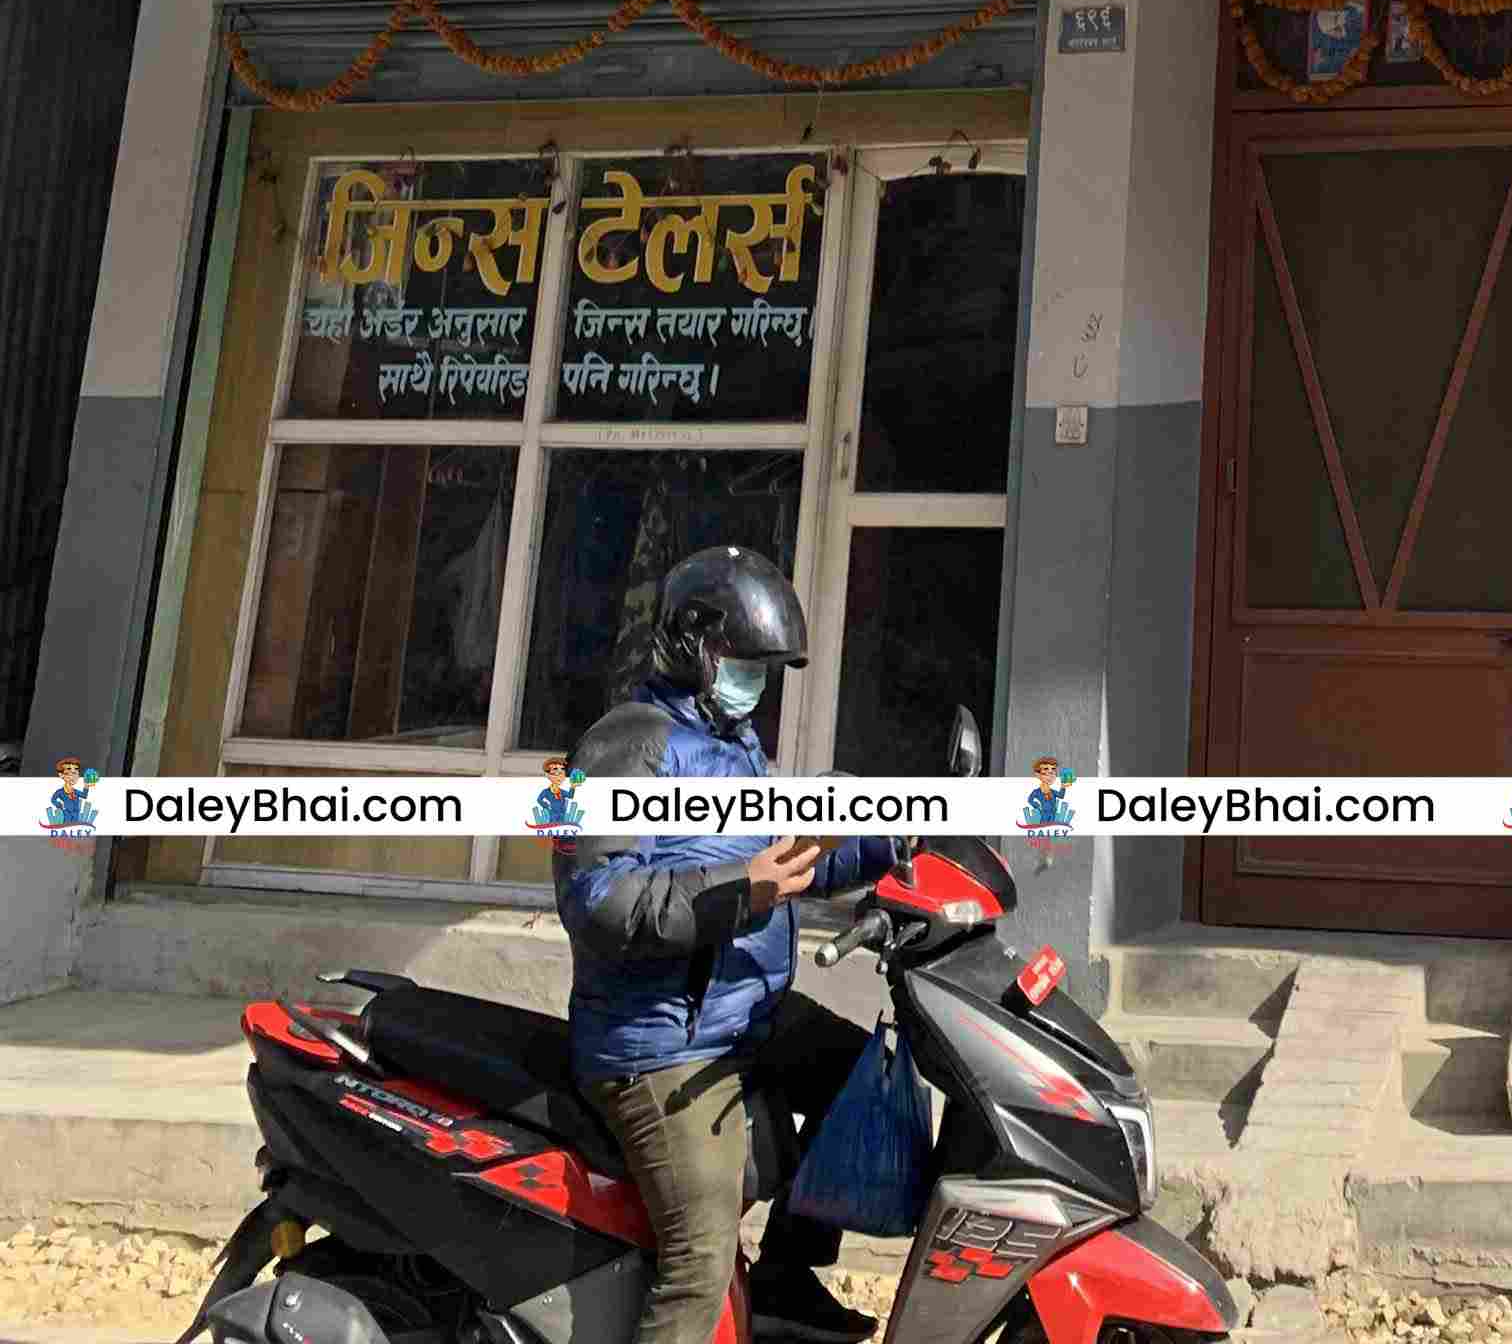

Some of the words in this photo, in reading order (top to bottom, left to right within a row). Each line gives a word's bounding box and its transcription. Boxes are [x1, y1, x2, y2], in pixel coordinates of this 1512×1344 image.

[319, 169, 551, 297] जिन्स
[577, 164, 817, 294] टेलर्स
[428, 306, 528, 348] अनुसार
[573, 298, 652, 345] जिन्स
[655, 307, 728, 347] तयार
[377, 350, 434, 403] साथै
[561, 352, 614, 395] पनि
